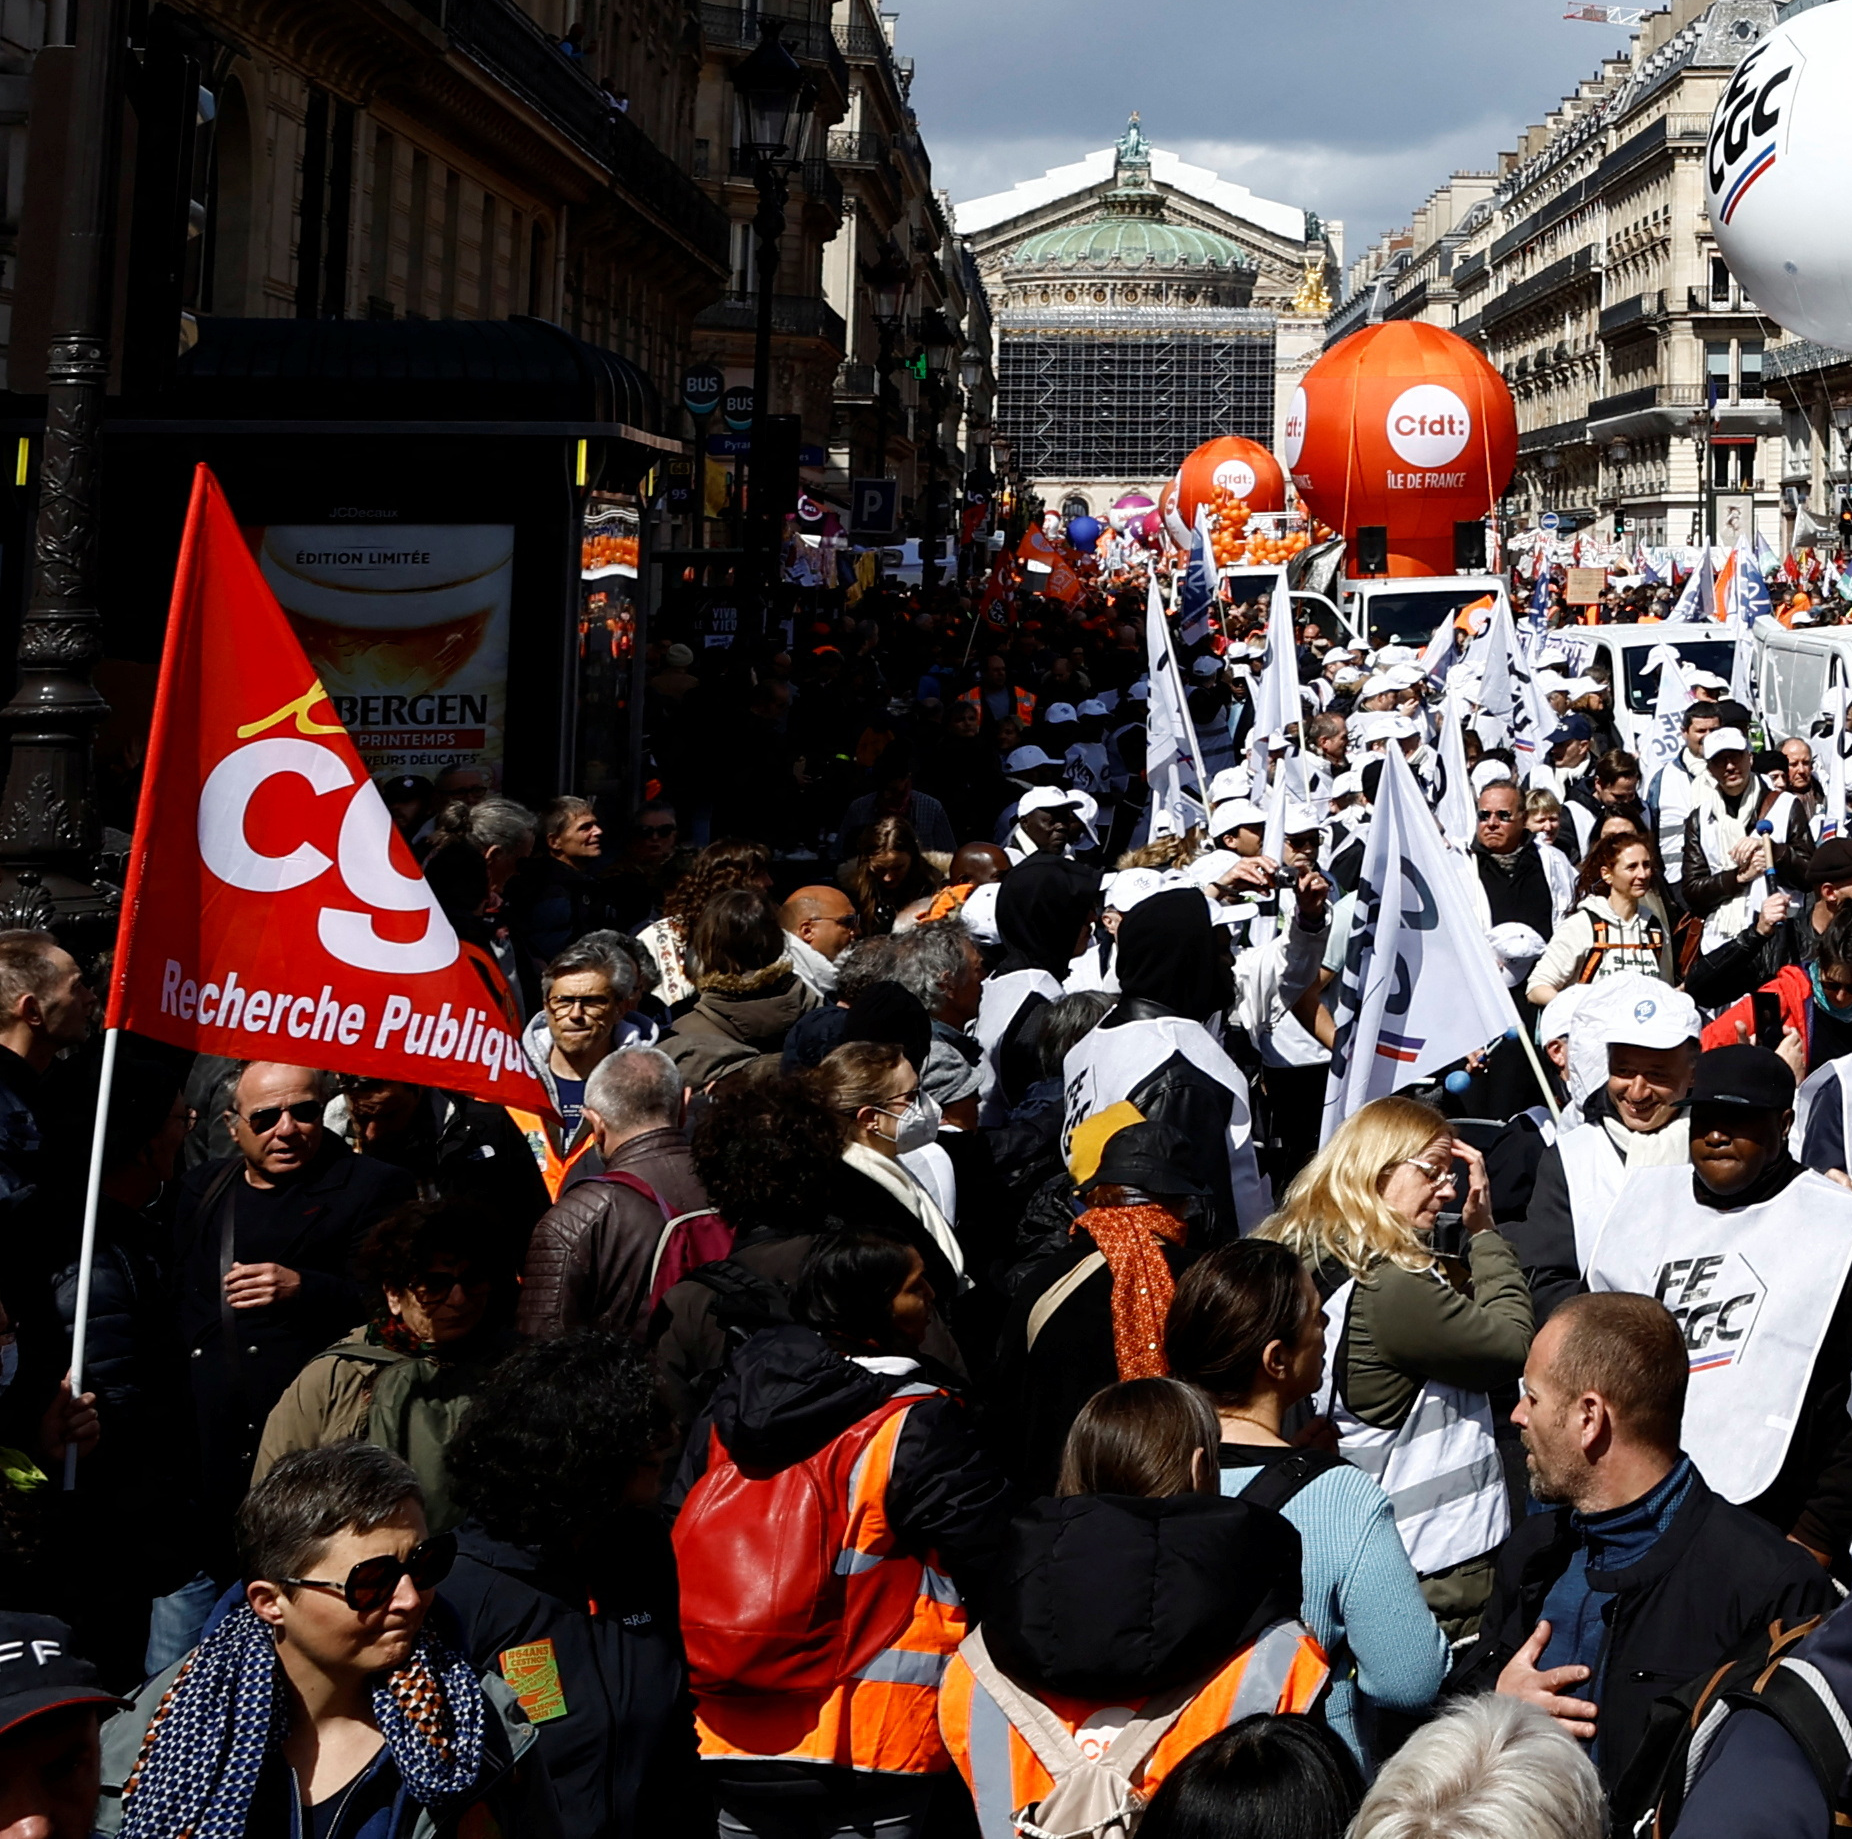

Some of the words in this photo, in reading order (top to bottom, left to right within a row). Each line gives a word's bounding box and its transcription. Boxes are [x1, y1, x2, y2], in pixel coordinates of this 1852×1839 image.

[686, 376, 718, 392] BUS
[726, 395, 753, 412] BUS
[1386, 469, 1407, 491] ÎLE
[1409, 472, 1424, 490] DE
[1427, 471, 1467, 490] FRANCE
[671, 488, 688, 500] 95
[328, 505, 398, 520] JCDecaux
[862, 488, 882, 521] P
[296, 547, 364, 566] ÉDITION
[368, 547, 431, 565] LIMITÉE
[359, 733, 457, 747] PRINTEMPS
[198, 738, 460, 974] cg
[160, 959, 365, 1047] Recherche
[631, 1612, 652, 1625] Rab
